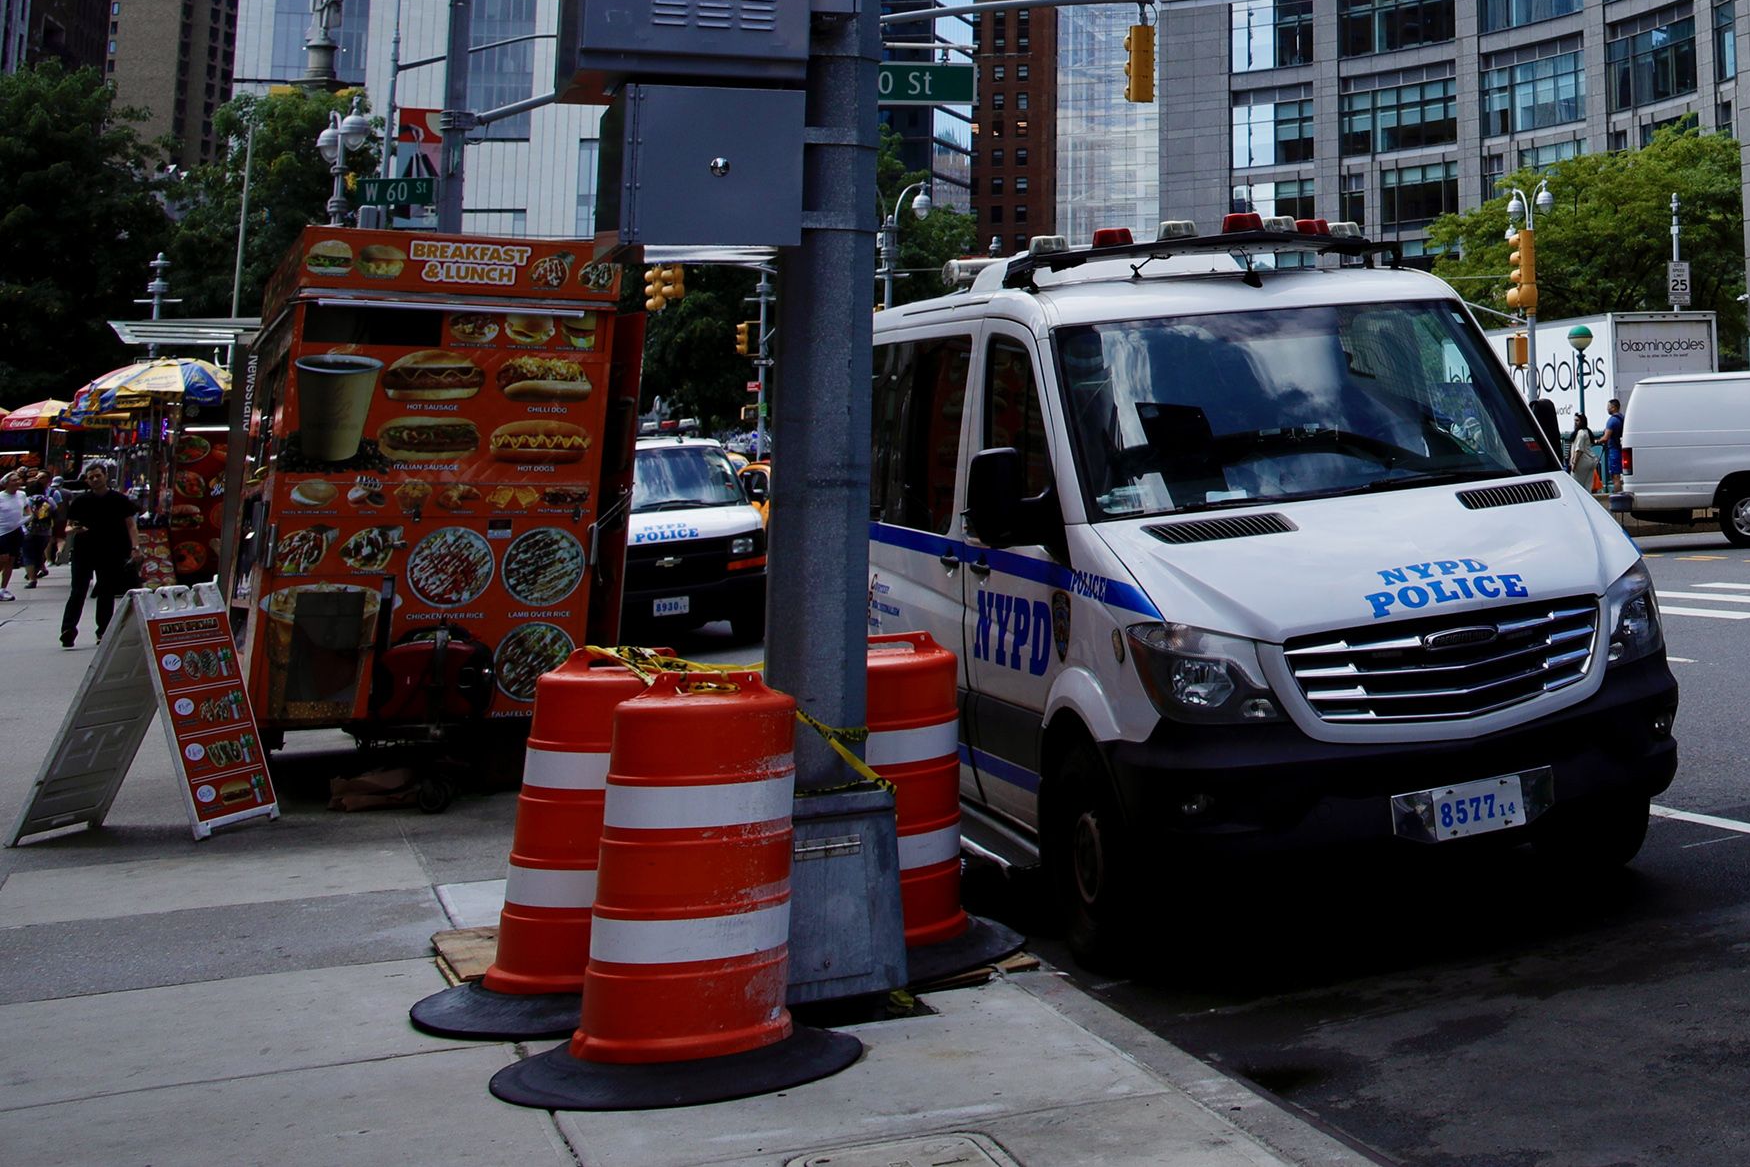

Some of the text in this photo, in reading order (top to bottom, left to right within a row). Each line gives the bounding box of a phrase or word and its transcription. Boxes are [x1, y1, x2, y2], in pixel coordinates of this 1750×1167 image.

[907, 71, 932, 95] St
[364, 181, 427, 202] W 60 St
[410, 240, 531, 266] BREAKFAST
[422, 263, 515, 285] & LUNCH
[1671, 279, 1688, 291] 25
[1620, 338, 1705, 354] bloomingdale's
[635, 528, 699, 543] POLICE
[643, 522, 687, 531] NYPD
[1377, 558, 1489, 586] NYPD
[1071, 568, 1107, 603] POLICE
[1364, 574, 1528, 619] POLICE
[656, 602, 679, 612] 8930
[974, 590, 1051, 677] NYPD
[1440, 793, 1516, 828] 8577 14
